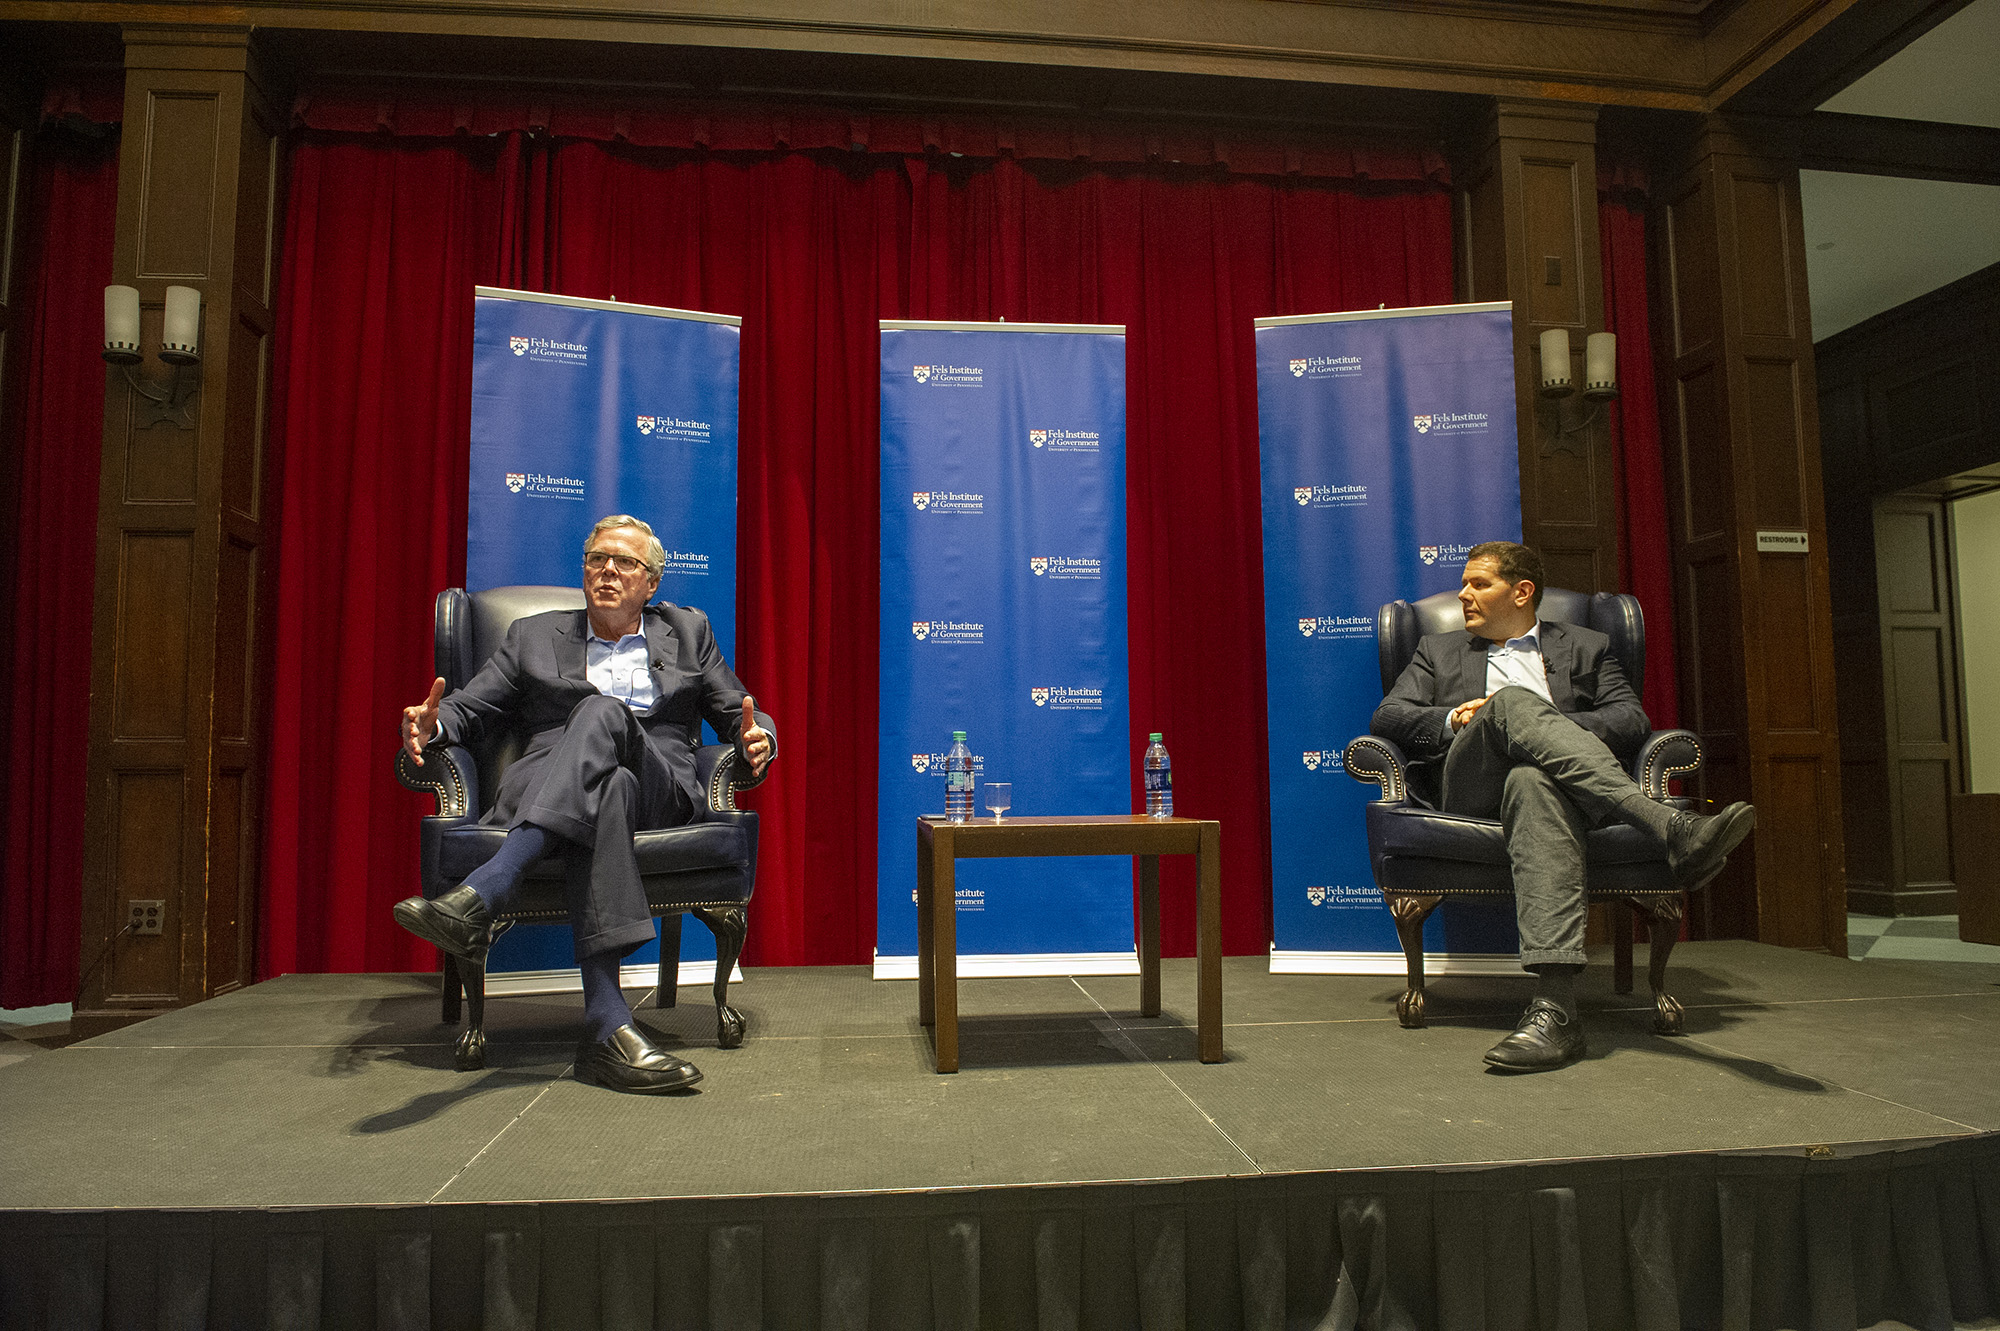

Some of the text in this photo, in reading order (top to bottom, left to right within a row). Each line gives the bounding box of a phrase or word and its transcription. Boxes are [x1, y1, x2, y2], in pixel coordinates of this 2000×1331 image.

[531, 338, 588, 352] Fels Institute
[530, 347, 587, 360] of Government
[1308, 356, 1362, 366] Fels Institute
[932, 365, 983, 375] Fels Institute
[1309, 365, 1362, 374] of Government
[1433, 412, 1488, 422] Fels Institute
[657, 417, 711, 430] Fels Institute
[1433, 421, 1488, 430] of Government
[666, 427, 710, 438] Government
[1048, 429, 1099, 439] Fels Institute
[527, 473, 584, 487] Fels Institute
[526, 483, 584, 494] of Government
[1313, 484, 1367, 494] Fels Institute
[931, 491, 983, 501] Fels Institute
[1313, 493, 1367, 502] of Government
[931, 500, 939, 508] of
[1440, 544, 1456, 554] Fels
[674, 551, 709, 562] Institute
[1049, 556, 1100, 566] Fels Institute
[1439, 553, 1447, 561] of
[1049, 565, 1057, 573] of
[1318, 616, 1372, 625] Fels Institute
[931, 621, 983, 631] Fels Institute
[1318, 625, 1372, 633] of Government
[1050, 687, 1102, 696] Fels Institute
[1059, 696, 1102, 704] Government
[1323, 750, 1339, 759] Fels
[1322, 759, 1330, 767] of
[955, 889, 984, 897] nstitute
[1327, 886, 1382, 895] Fels Institute
[1326, 895, 1335, 903] of
